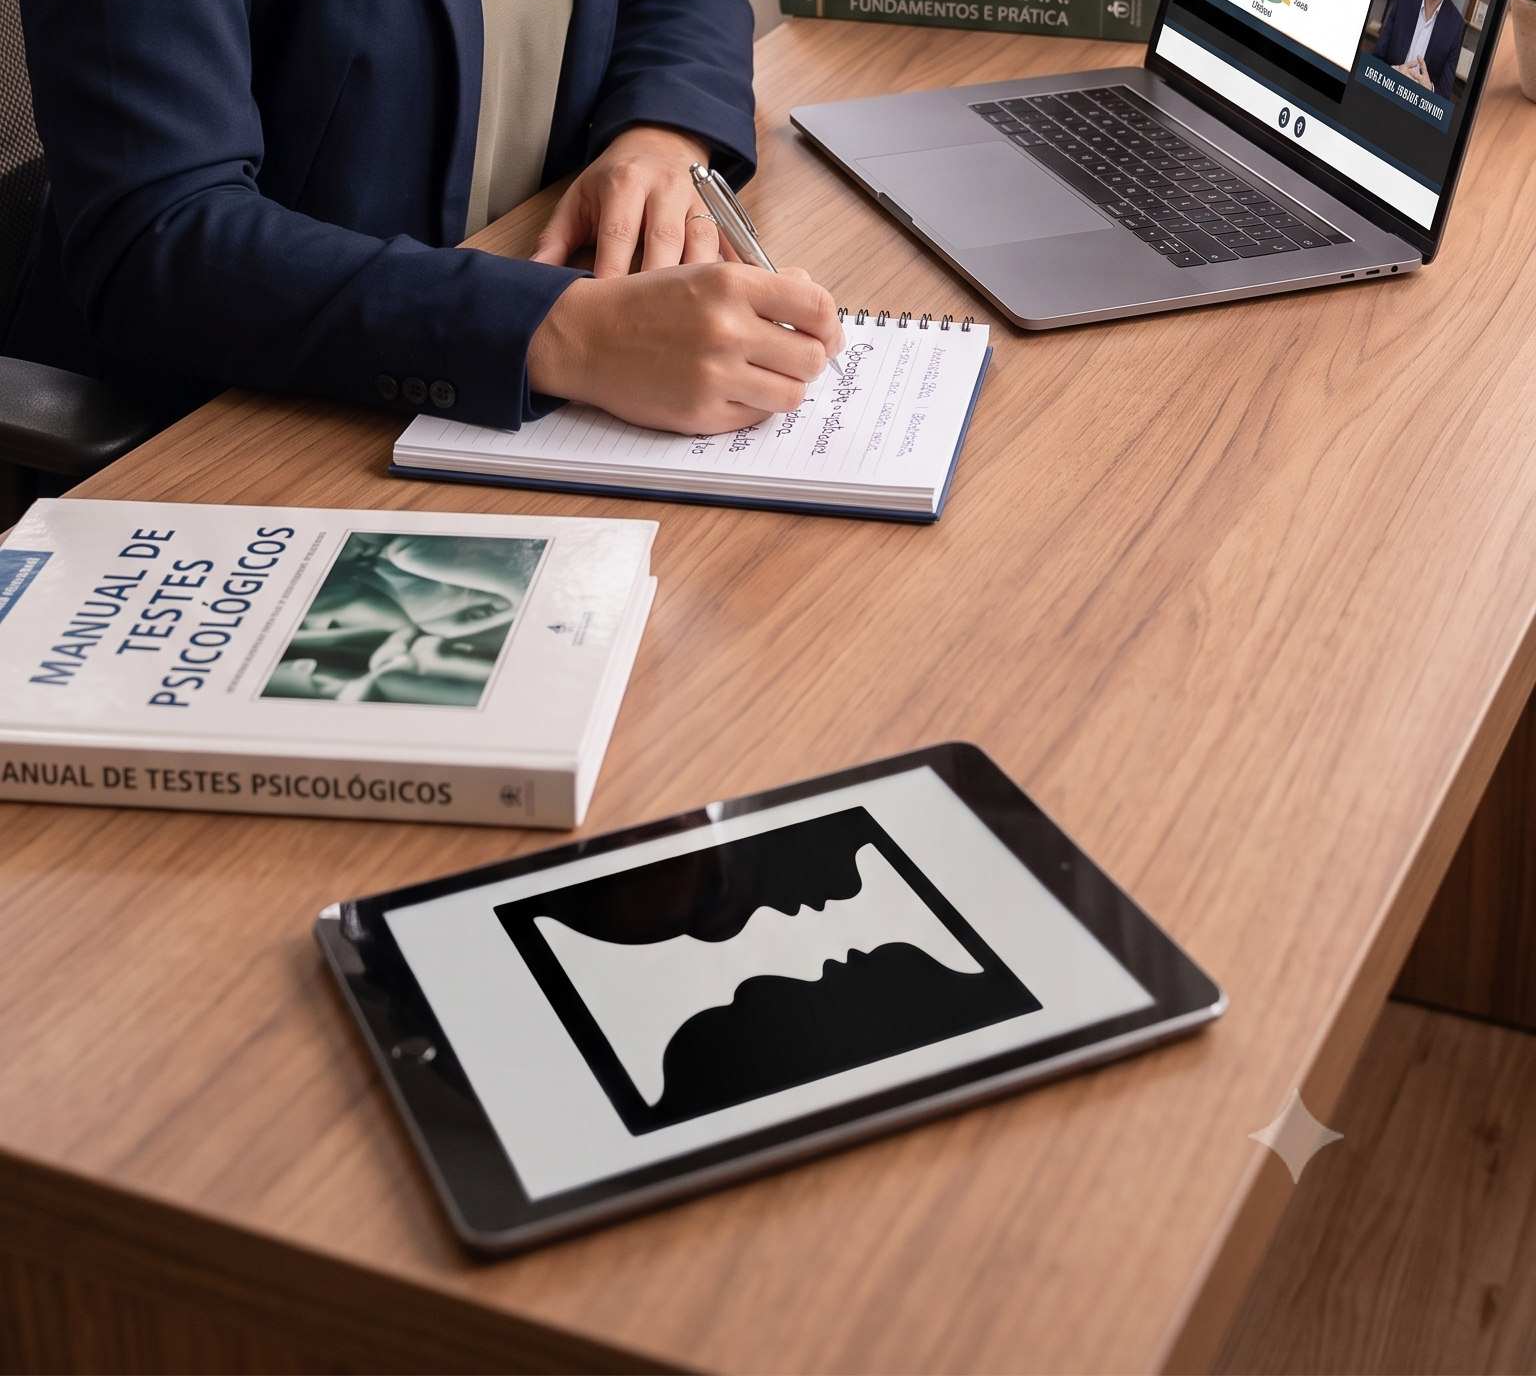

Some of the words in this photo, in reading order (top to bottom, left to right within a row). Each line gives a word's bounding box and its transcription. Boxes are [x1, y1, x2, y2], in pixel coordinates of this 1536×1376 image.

[983, 4, 993, 21] E
[997, 4, 1069, 26] PRÁTICA
[28, 569, 148, 686] MANUAL
[118, 528, 176, 559] DE
[116, 559, 214, 655] TESTES
[147, 526, 295, 708] PSICOLÓGICOS
[0, 760, 94, 788] ANUAL
[103, 766, 137, 790] DE
[145, 768, 241, 795] TESTES
[251, 773, 453, 806] PSICOLÓGICOS
